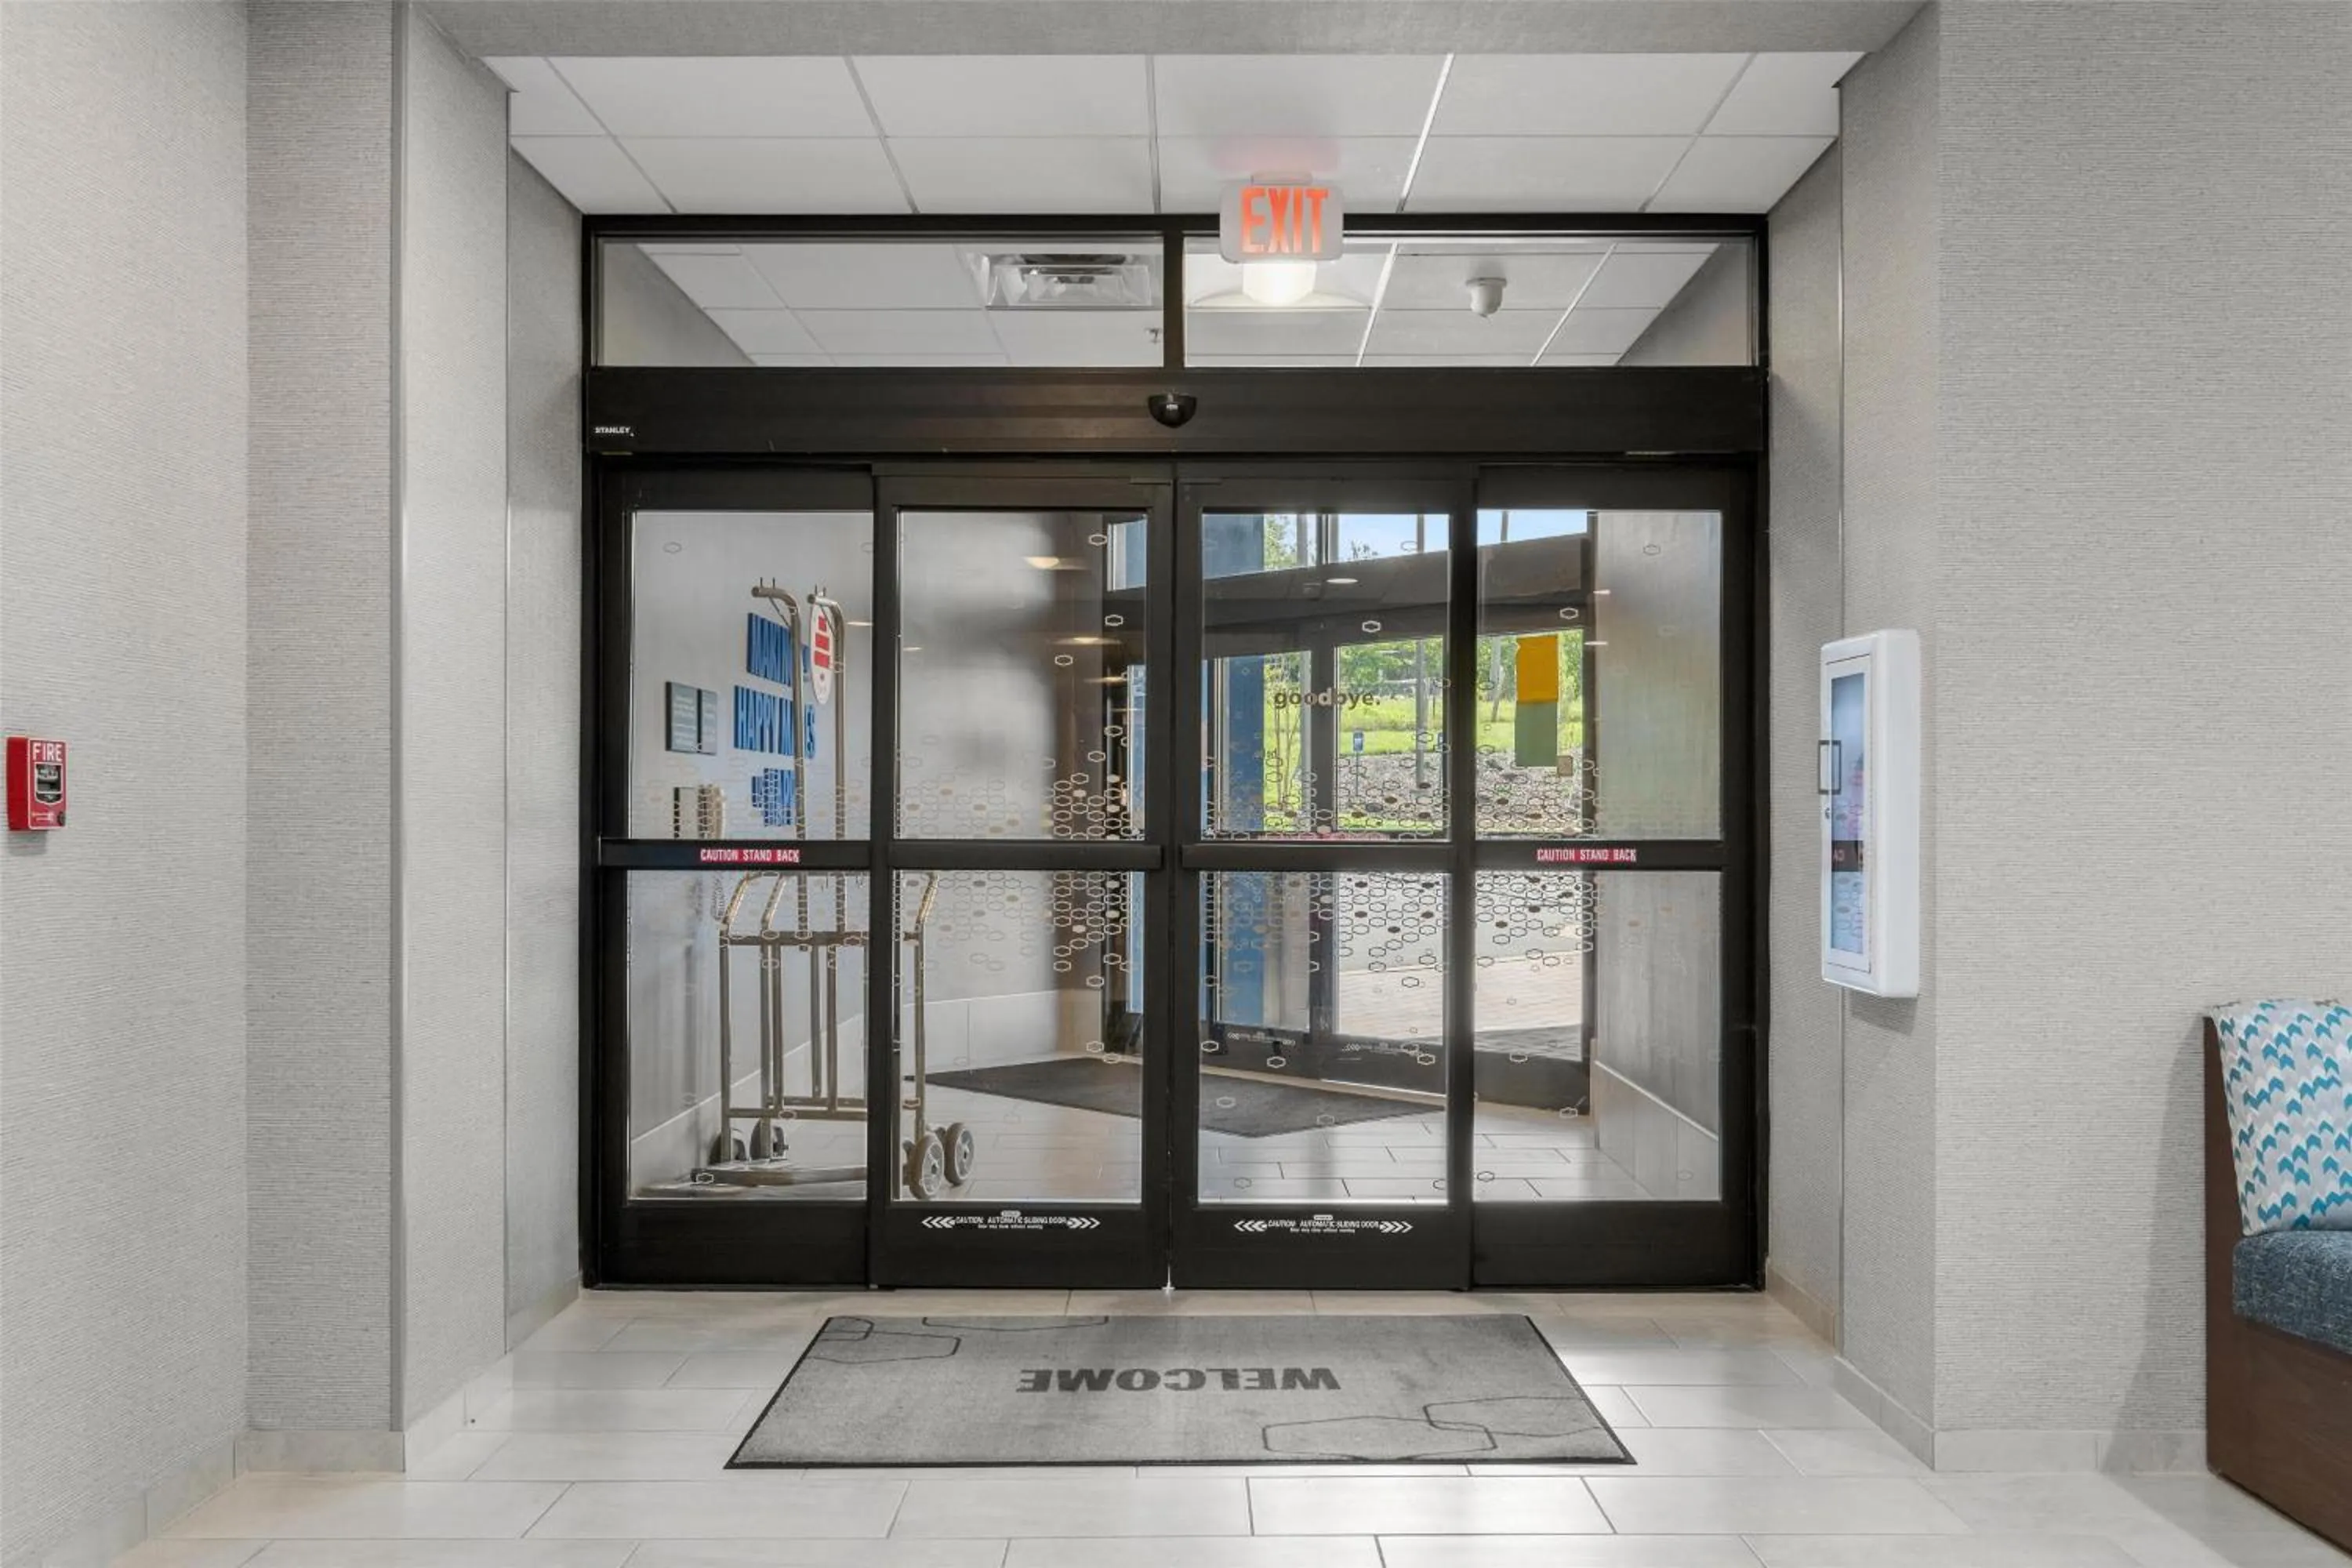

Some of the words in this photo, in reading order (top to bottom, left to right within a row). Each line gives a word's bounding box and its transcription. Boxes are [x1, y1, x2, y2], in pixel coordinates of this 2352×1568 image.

[1240, 187, 1330, 254] EXIT
[746, 612, 811, 687] MAKIN
[1273, 687, 1381, 710] goodbye.
[734, 685, 780, 753] HAPPY
[31, 742, 64, 761] FIRE
[700, 848, 739, 861] CAUTION
[742, 849, 772, 862] STAND
[777, 849, 800, 862] BACK
[1537, 848, 1575, 861] CAUTION
[1580, 848, 1610, 862] STAND
[1613, 848, 1637, 862] BACK
[1016, 1367, 1341, 1392] WELCOME
